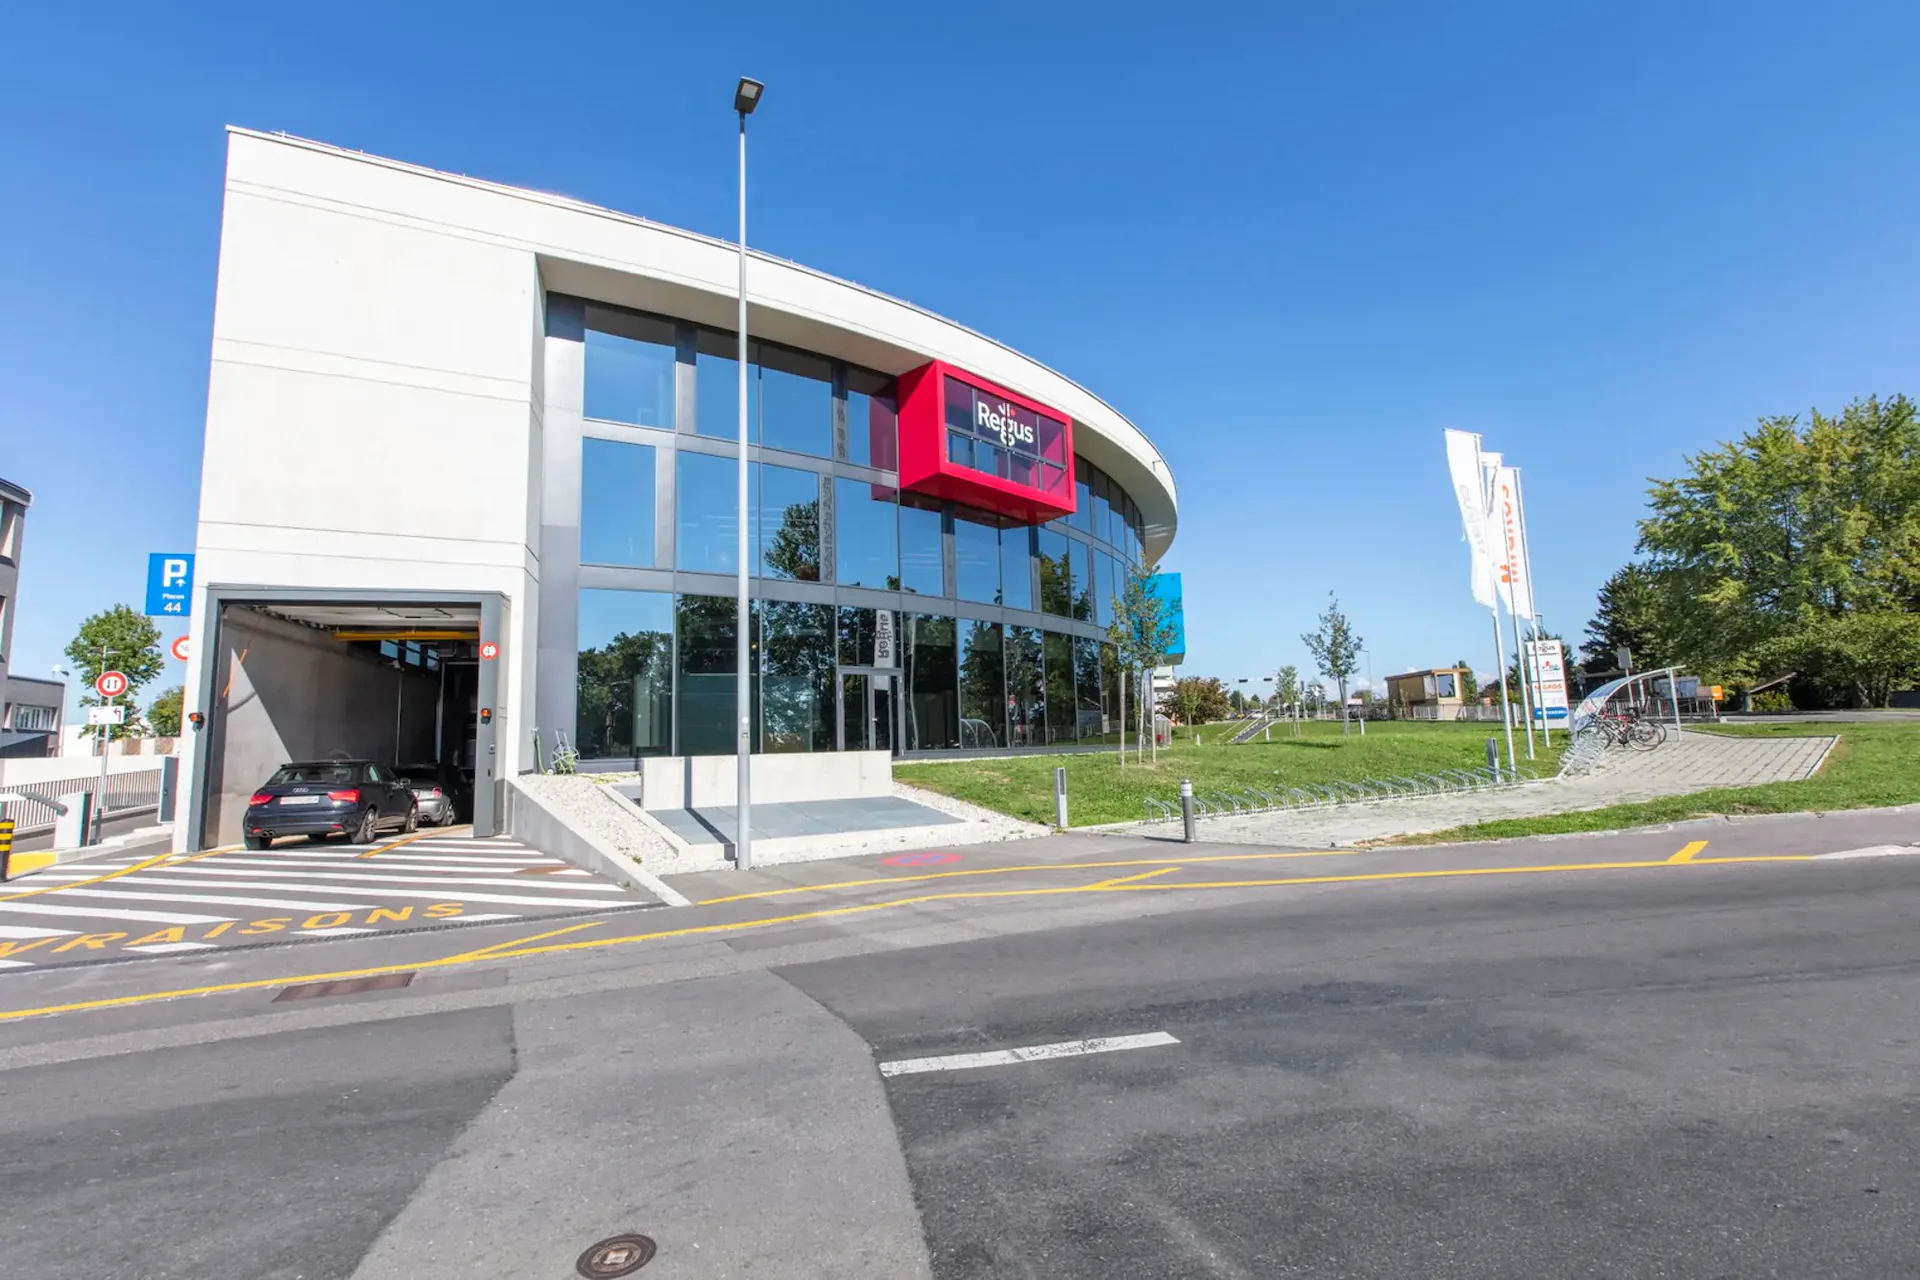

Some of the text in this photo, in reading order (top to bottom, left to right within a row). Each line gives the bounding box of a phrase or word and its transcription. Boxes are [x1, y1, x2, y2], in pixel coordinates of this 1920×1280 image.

[978, 401, 1034, 446] Regus
[163, 559, 187, 588] P
[164, 602, 182, 613] 44
